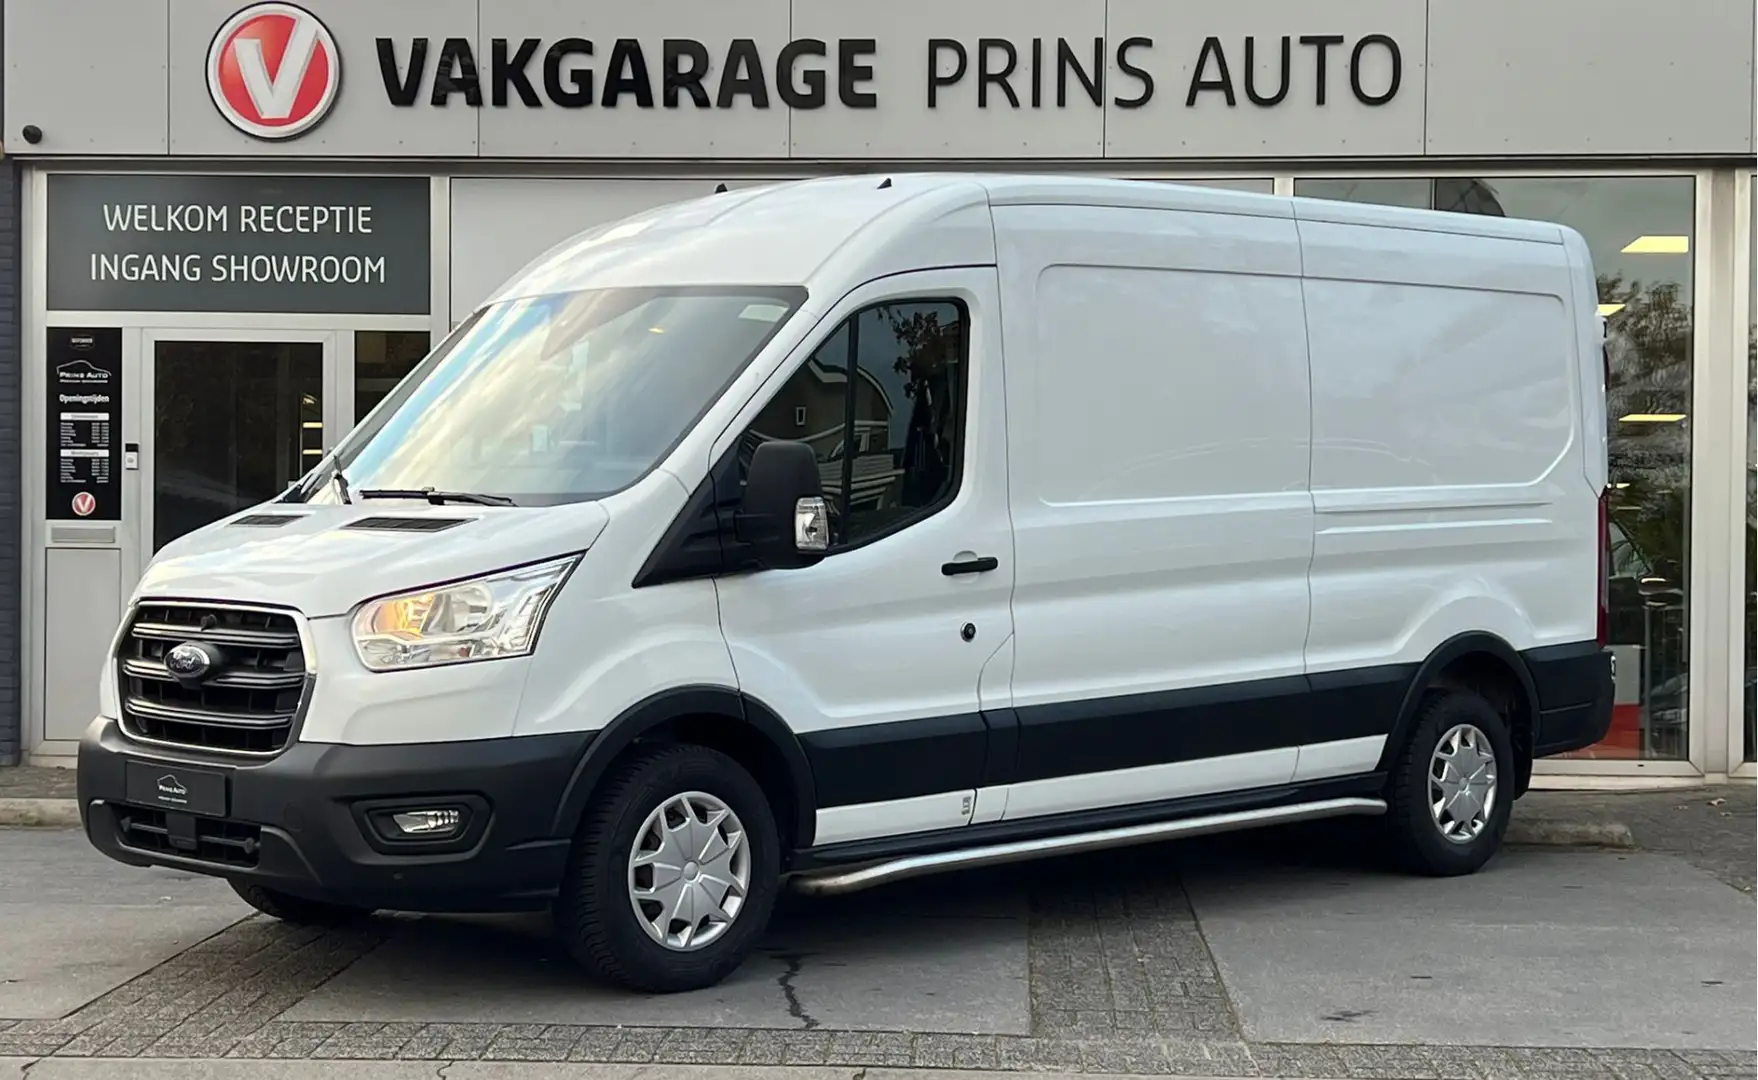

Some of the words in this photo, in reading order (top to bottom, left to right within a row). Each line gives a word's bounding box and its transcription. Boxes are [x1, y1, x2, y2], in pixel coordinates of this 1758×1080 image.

[376, 37, 876, 109] VAKGARAGE
[927, 37, 1154, 109] PRINS
[1185, 34, 1402, 108] AUTO
[103, 204, 228, 233] WELKOM
[240, 205, 372, 234] RECEPTIE
[91, 253, 201, 282] INGANG
[211, 254, 385, 284] SHOWROOM
[59, 393, 110, 405] Openingstijden
